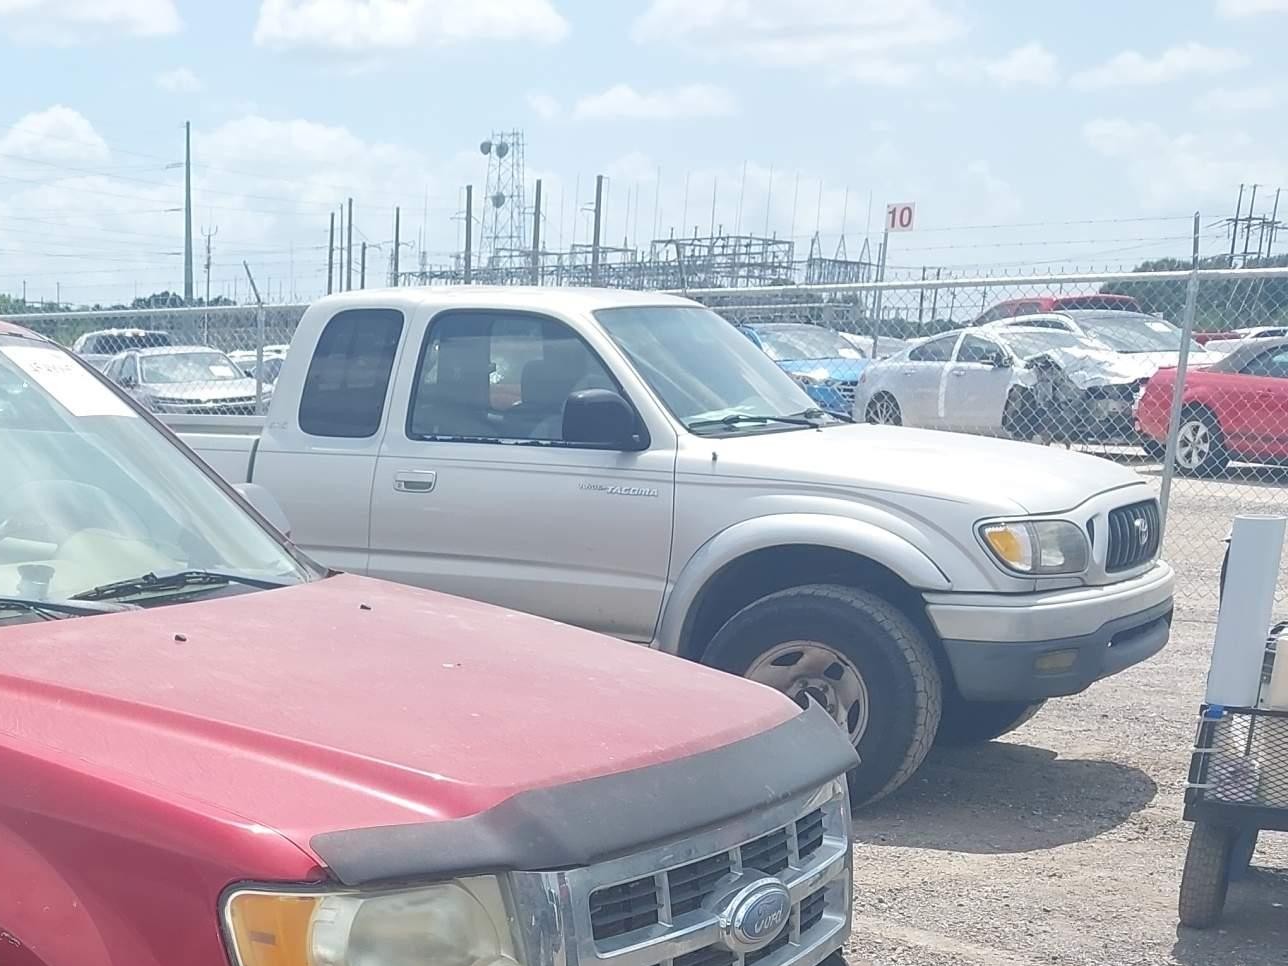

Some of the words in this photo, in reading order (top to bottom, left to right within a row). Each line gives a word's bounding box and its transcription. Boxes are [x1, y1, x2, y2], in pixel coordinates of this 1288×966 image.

[888, 206, 913, 228] 10
[607, 485, 659, 497] TACOMA
[754, 898, 784, 934] Ford
